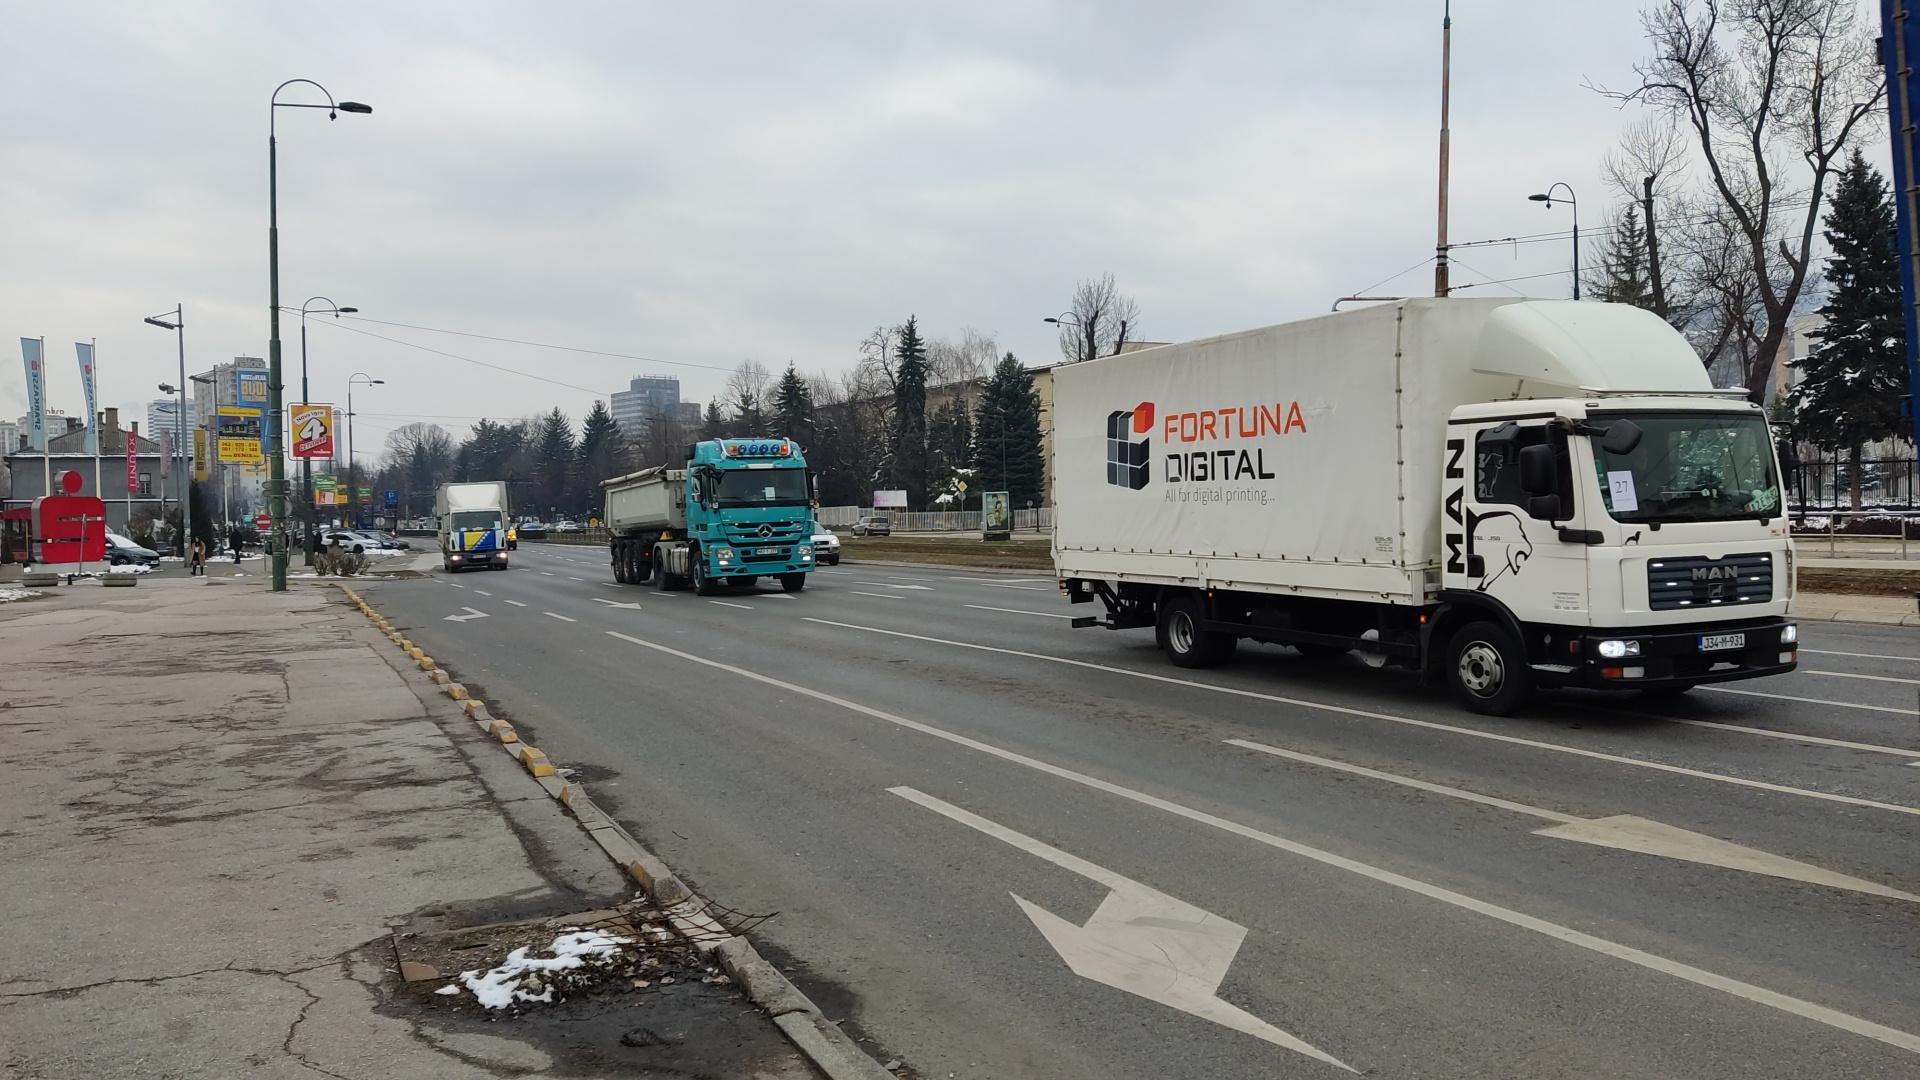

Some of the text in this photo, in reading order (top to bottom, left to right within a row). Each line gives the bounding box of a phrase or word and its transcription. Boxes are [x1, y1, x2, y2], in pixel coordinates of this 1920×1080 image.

[1164, 401, 1307, 444] FORTUNA
[1165, 448, 1275, 483] DIGITAL
[1165, 487, 1275, 506] All for digital printing...
[1615, 481, 1628, 494] 27
[1446, 439, 1465, 573] MAN
[1692, 565, 1738, 580] MAN
[1703, 635, 1744, 649] J34-M-931
